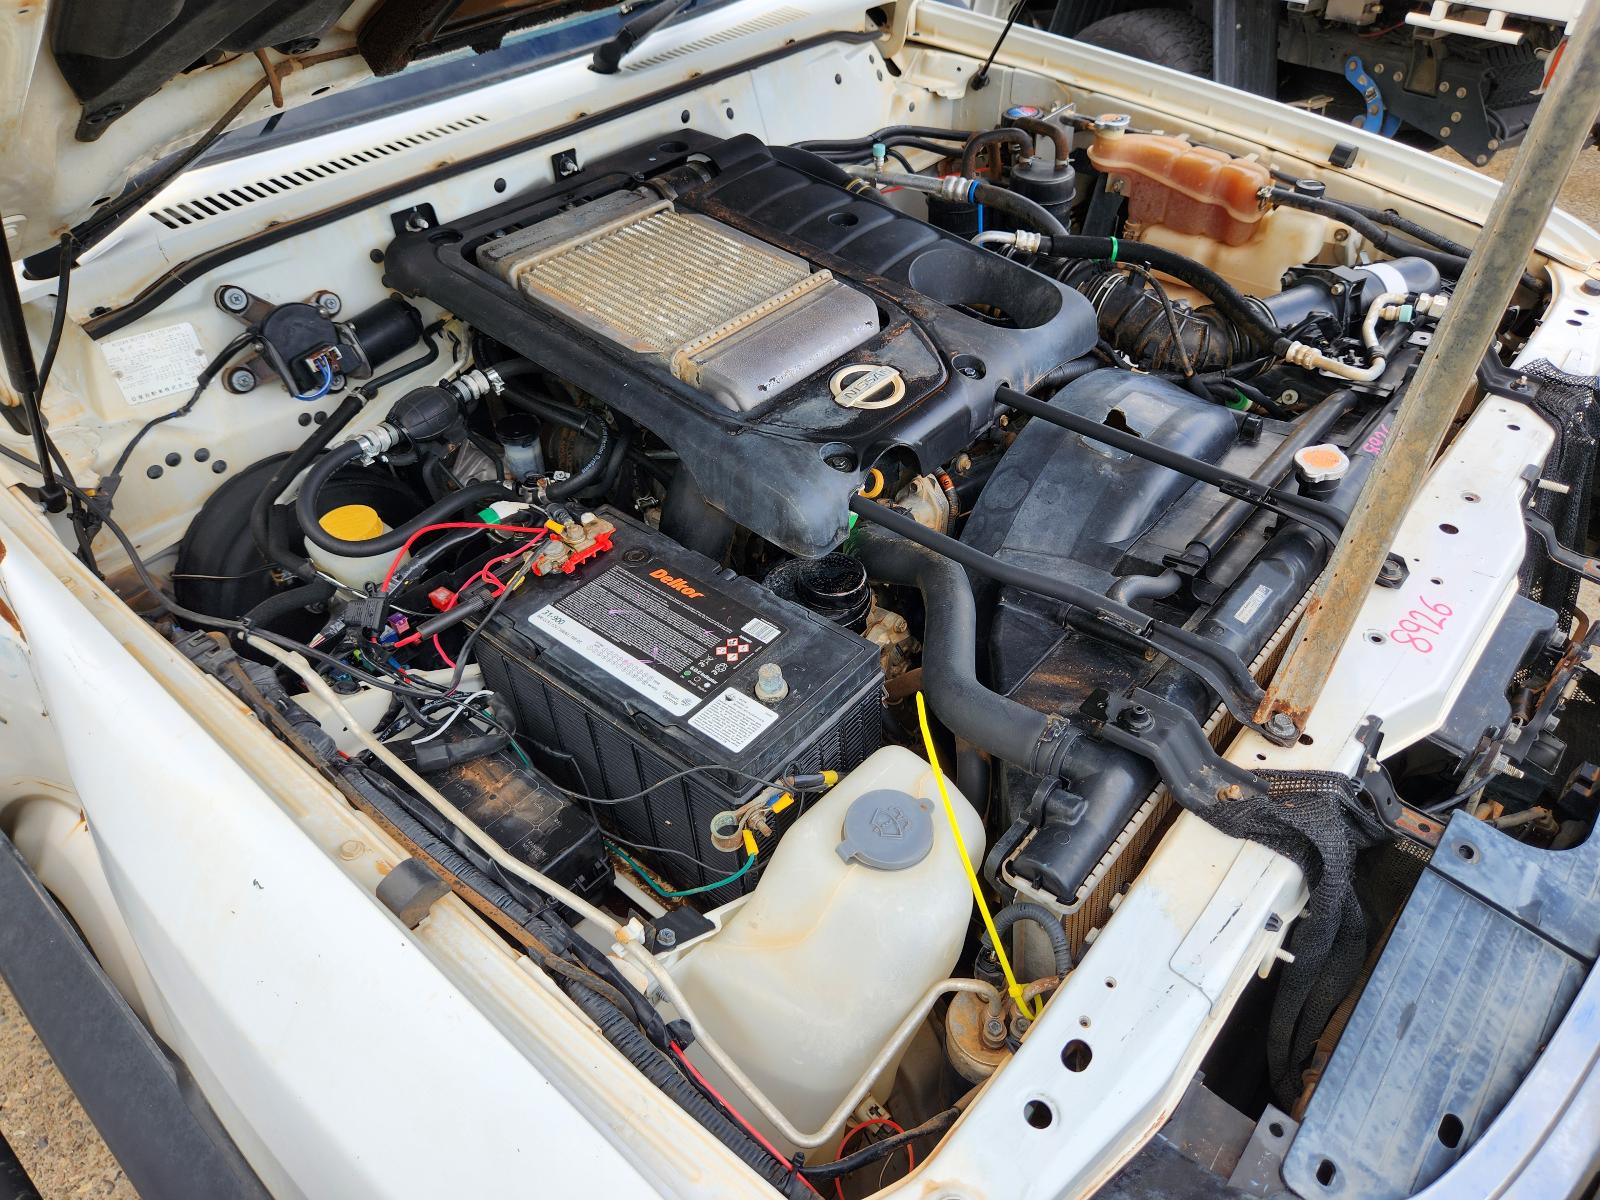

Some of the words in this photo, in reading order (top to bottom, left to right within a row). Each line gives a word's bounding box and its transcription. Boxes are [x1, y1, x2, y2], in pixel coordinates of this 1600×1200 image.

[843, 368, 893, 399] NISSAN
[648, 567, 705, 599] Delkor
[1390, 595, 1453, 653] 8926
